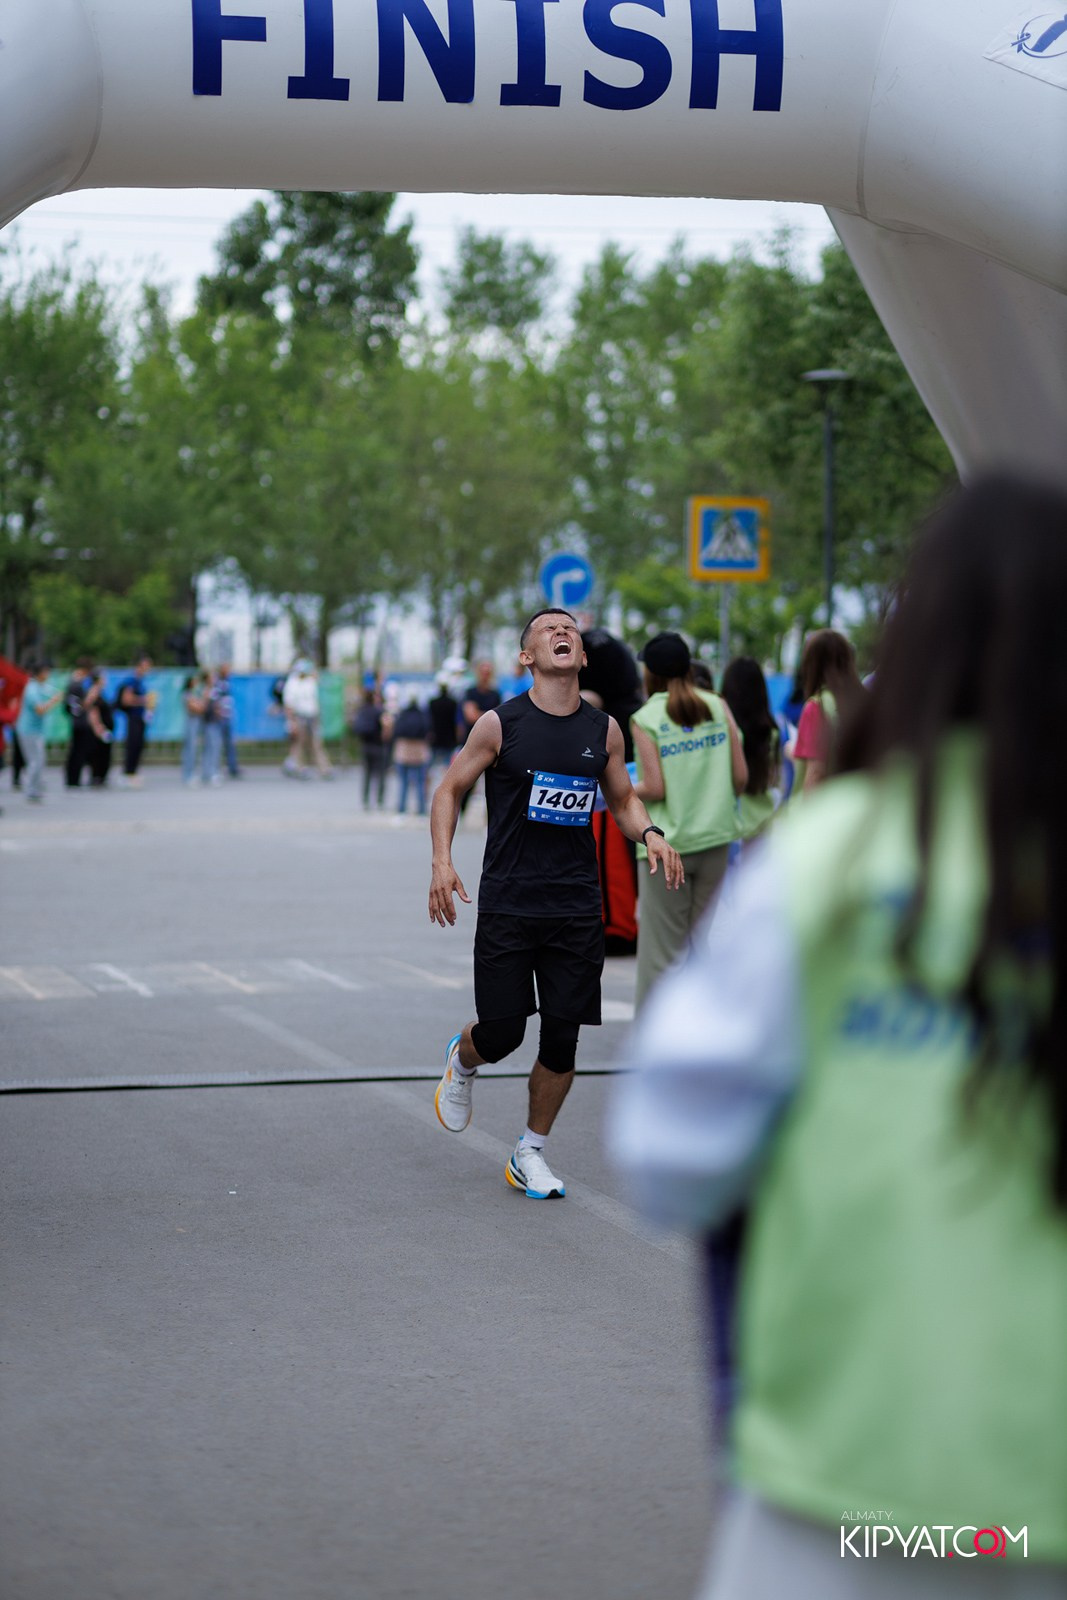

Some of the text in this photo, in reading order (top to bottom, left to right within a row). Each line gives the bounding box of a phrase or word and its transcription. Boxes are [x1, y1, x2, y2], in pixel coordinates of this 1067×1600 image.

[193, 0, 784, 111] FINISH
[661, 732, 727, 758] ВОЛОНТЕР
[537, 789, 590, 810] 1404
